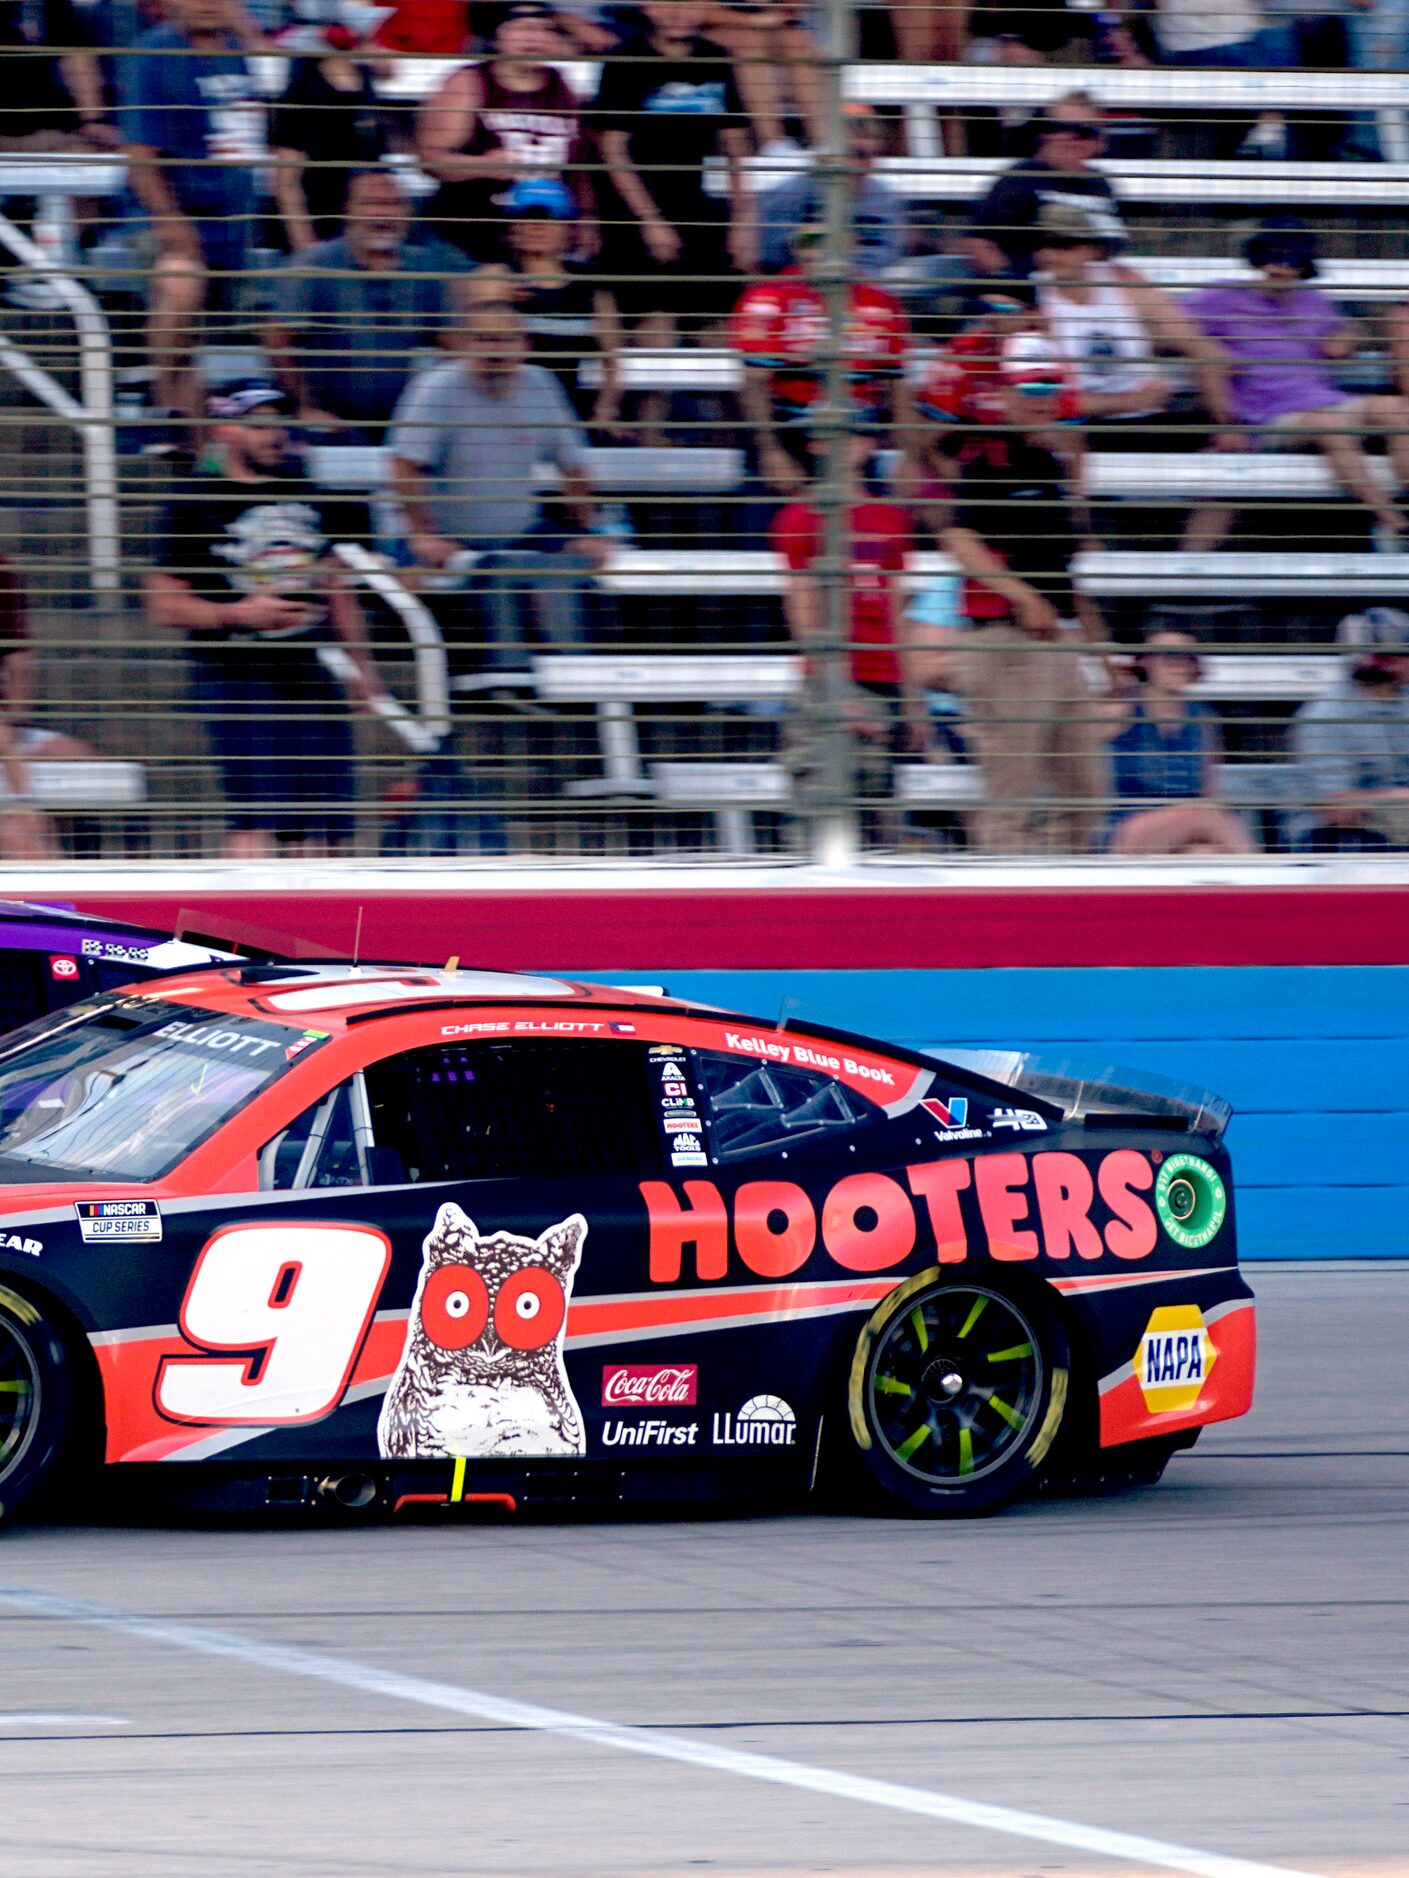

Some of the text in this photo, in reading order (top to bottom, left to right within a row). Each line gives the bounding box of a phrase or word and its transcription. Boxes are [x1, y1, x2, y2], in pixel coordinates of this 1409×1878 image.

[153, 1021, 282, 1056] ELLIOTT
[441, 1021, 604, 1035] CHASE ELLIOTT
[725, 1033, 895, 1085] Kelley Blue Book
[934, 1128, 983, 1142] Valvoline
[92, 1219, 150, 1233] CUP SERIES
[103, 1203, 147, 1216] NASCAR
[638, 1149, 1158, 1283] HOOTERS
[153, 1220, 392, 1427] 9
[1147, 1335, 1202, 1383] NAPA
[604, 1368, 696, 1402] Coca-Cola
[601, 1420, 700, 1445] UniFirst
[712, 1412, 797, 1444] LLumar
